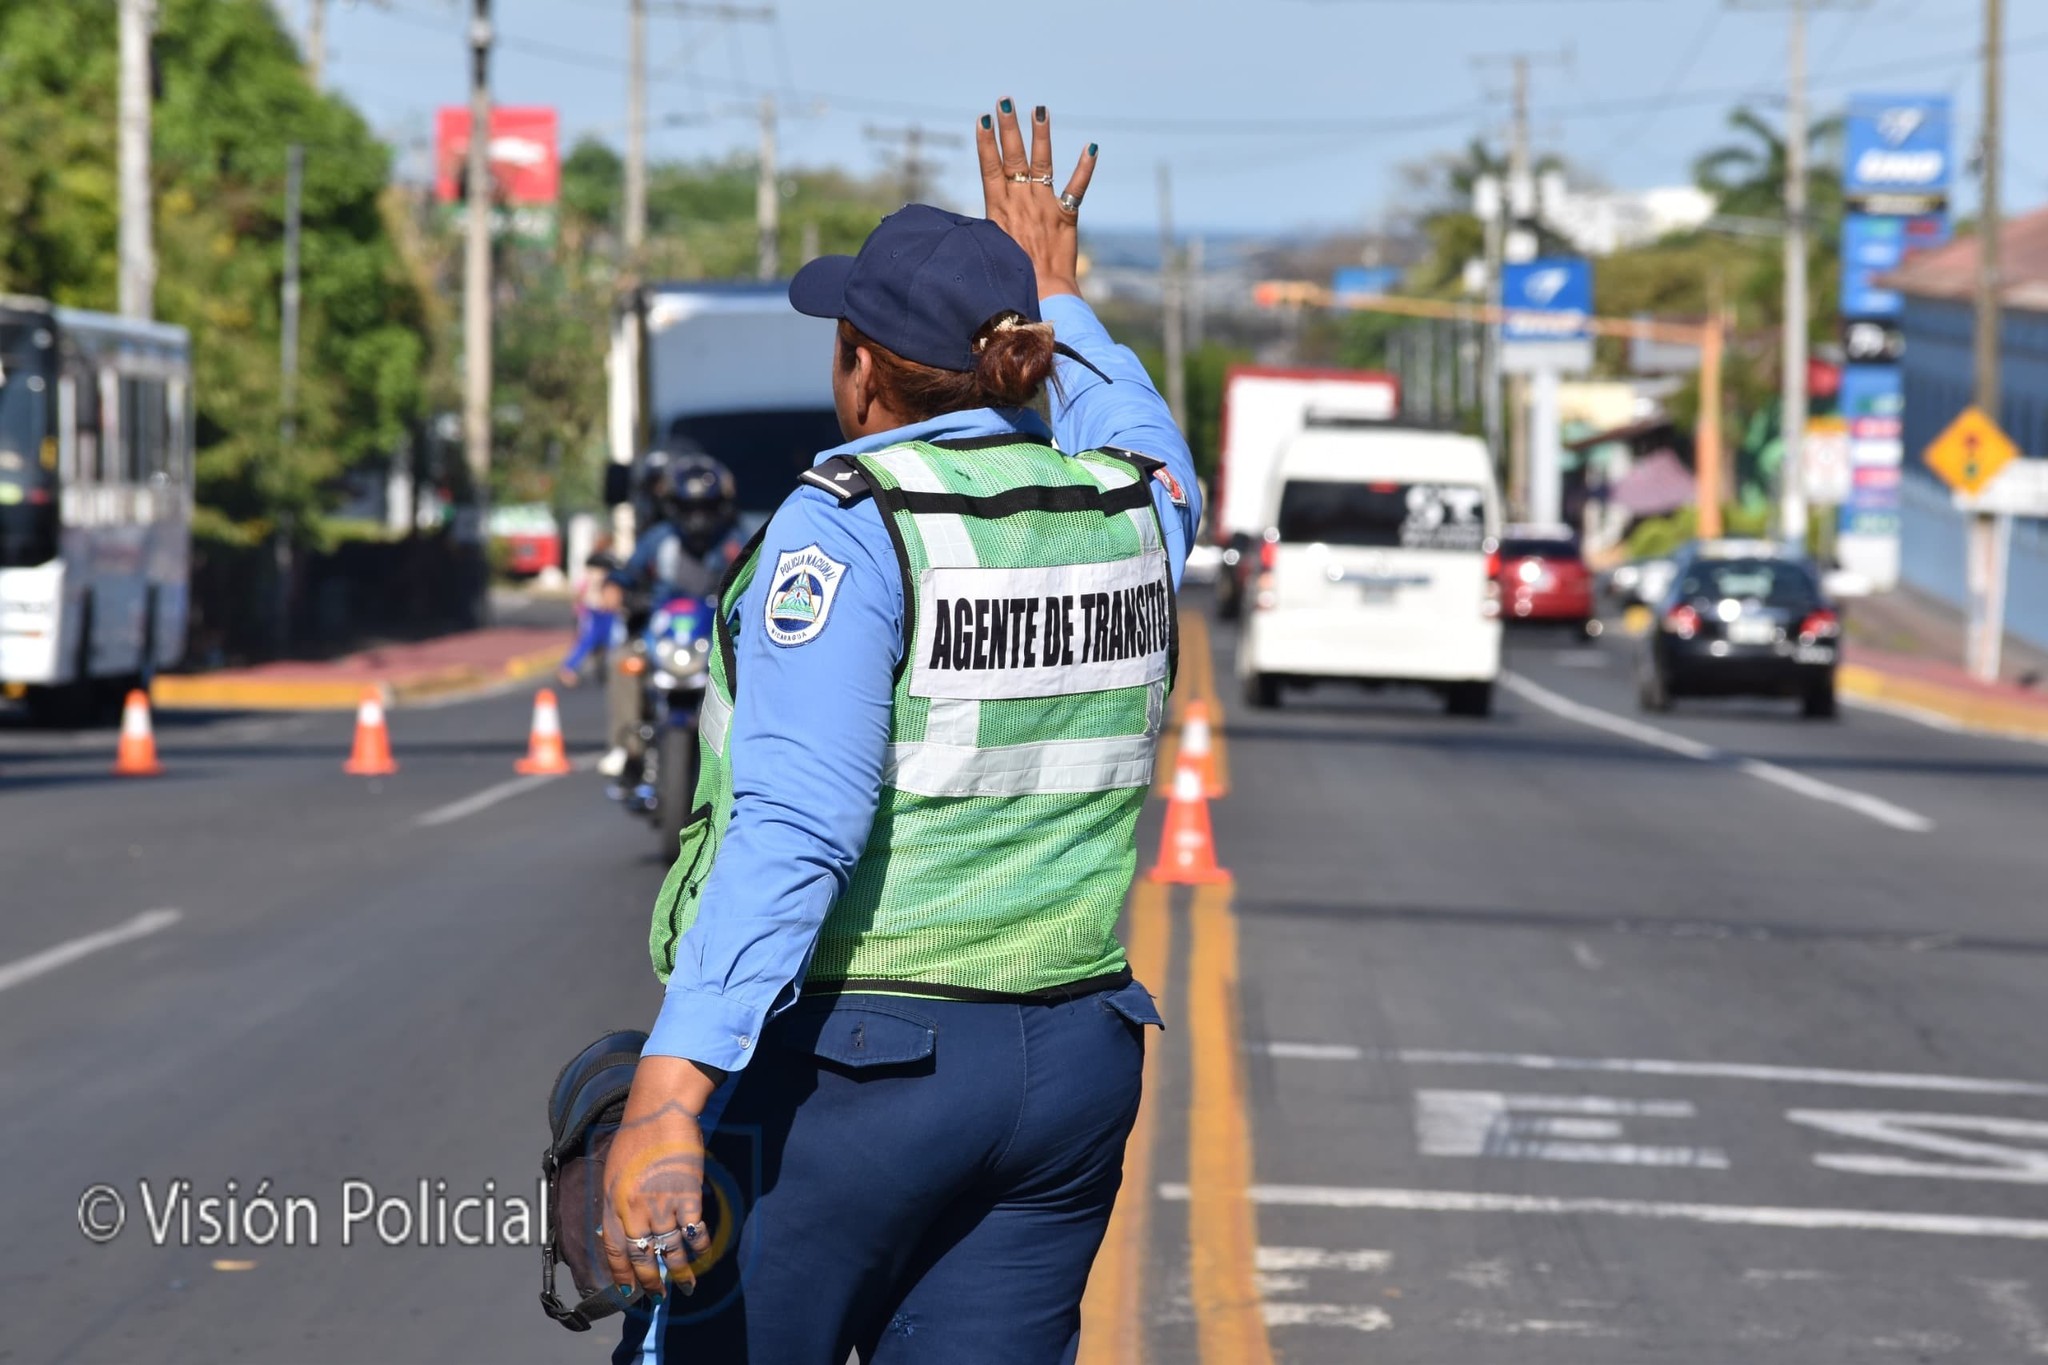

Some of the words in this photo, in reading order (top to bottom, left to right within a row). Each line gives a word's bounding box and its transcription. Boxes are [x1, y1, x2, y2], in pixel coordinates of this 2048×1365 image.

[780, 554, 805, 576] POLICIA
[806, 554, 837, 582] NACIONAL
[771, 628, 807, 642] NICARAGUA
[929, 598, 1039, 671] AGENTE
[1042, 595, 1073, 667] DE
[1081, 579, 1168, 664] TRANSITO
